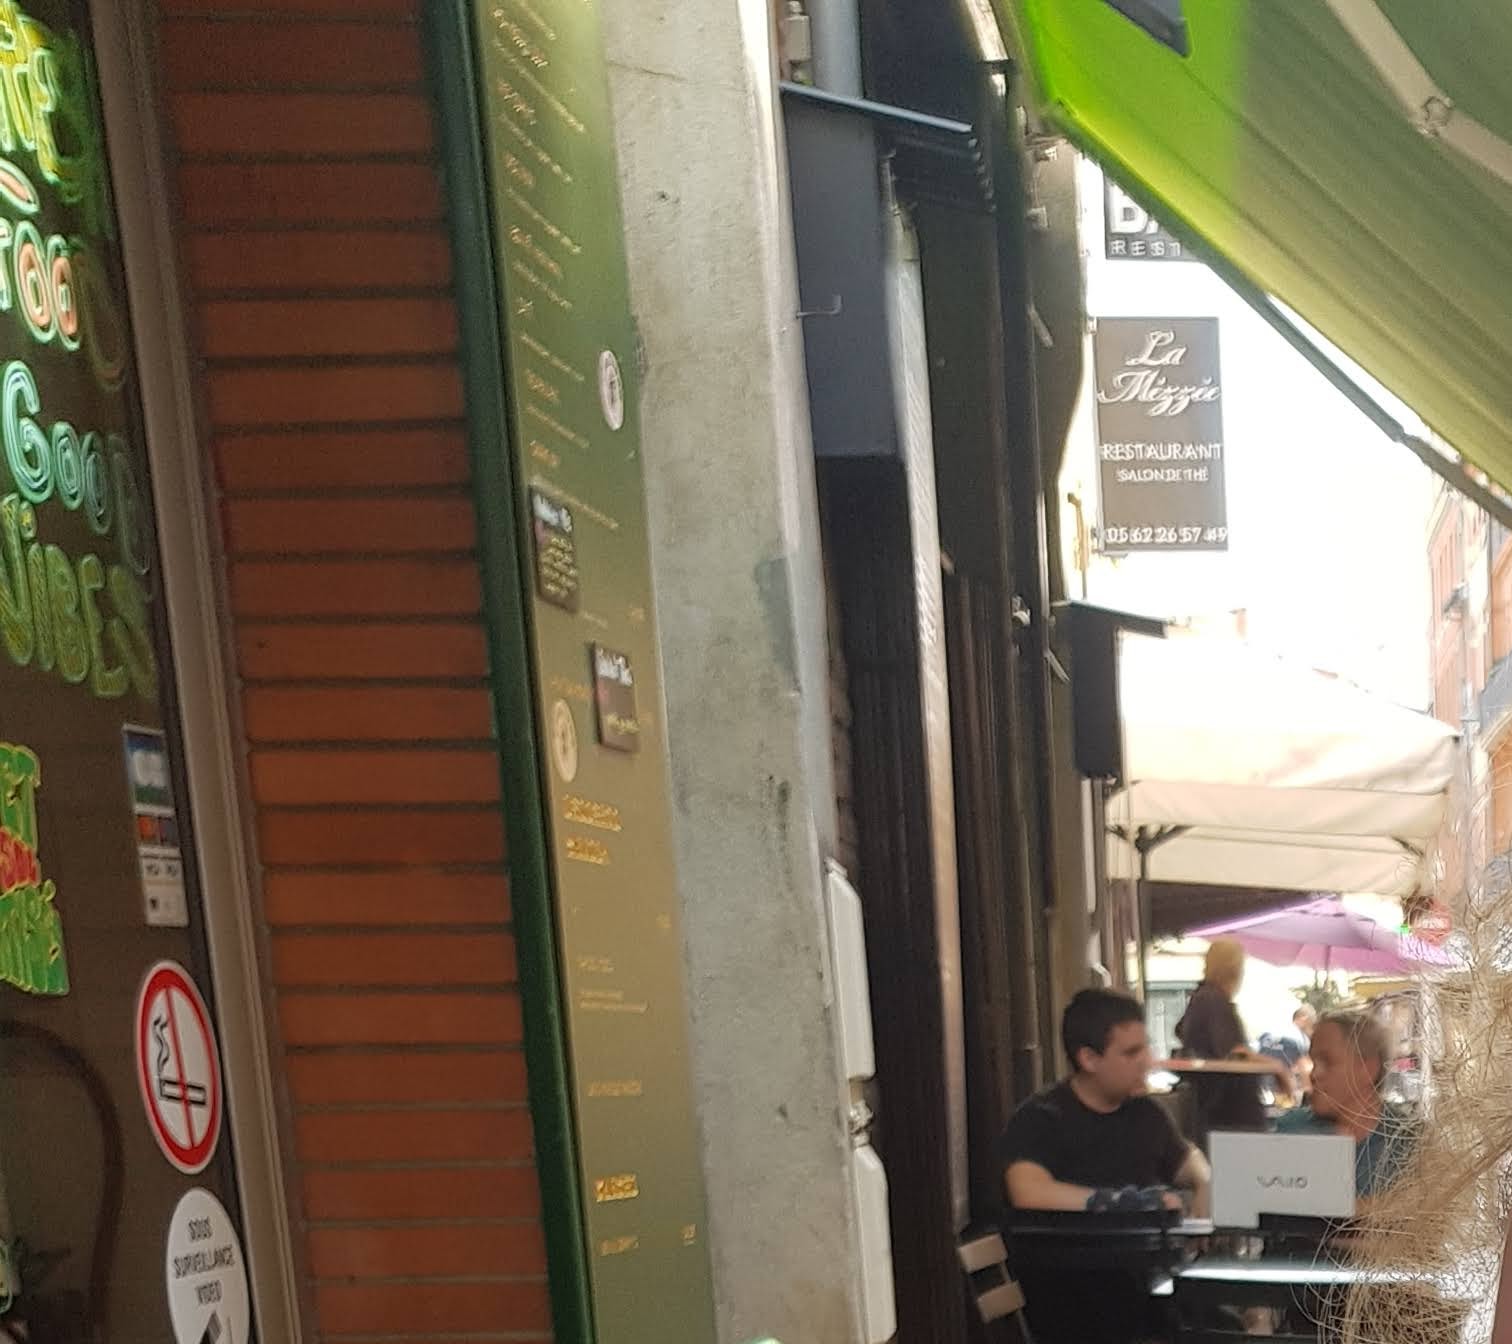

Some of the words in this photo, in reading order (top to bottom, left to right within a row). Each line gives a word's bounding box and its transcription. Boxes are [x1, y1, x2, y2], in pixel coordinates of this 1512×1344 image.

[1125, 329, 1188, 367] La
[1102, 442, 1221, 461] RESTAURANT
[1117, 467, 1164, 483] SALON
[1166, 467, 1182, 482] DE
[1106, 526, 1129, 545] 05
[1130, 526, 1153, 545] 62
[1155, 526, 1178, 545] 26
[1179, 526, 1203, 545] 57
[1256, 1174, 1309, 1190] VAIO
[187, 1216, 213, 1243] SOUS
[173, 1243, 236, 1280] SURVEILLANCE
